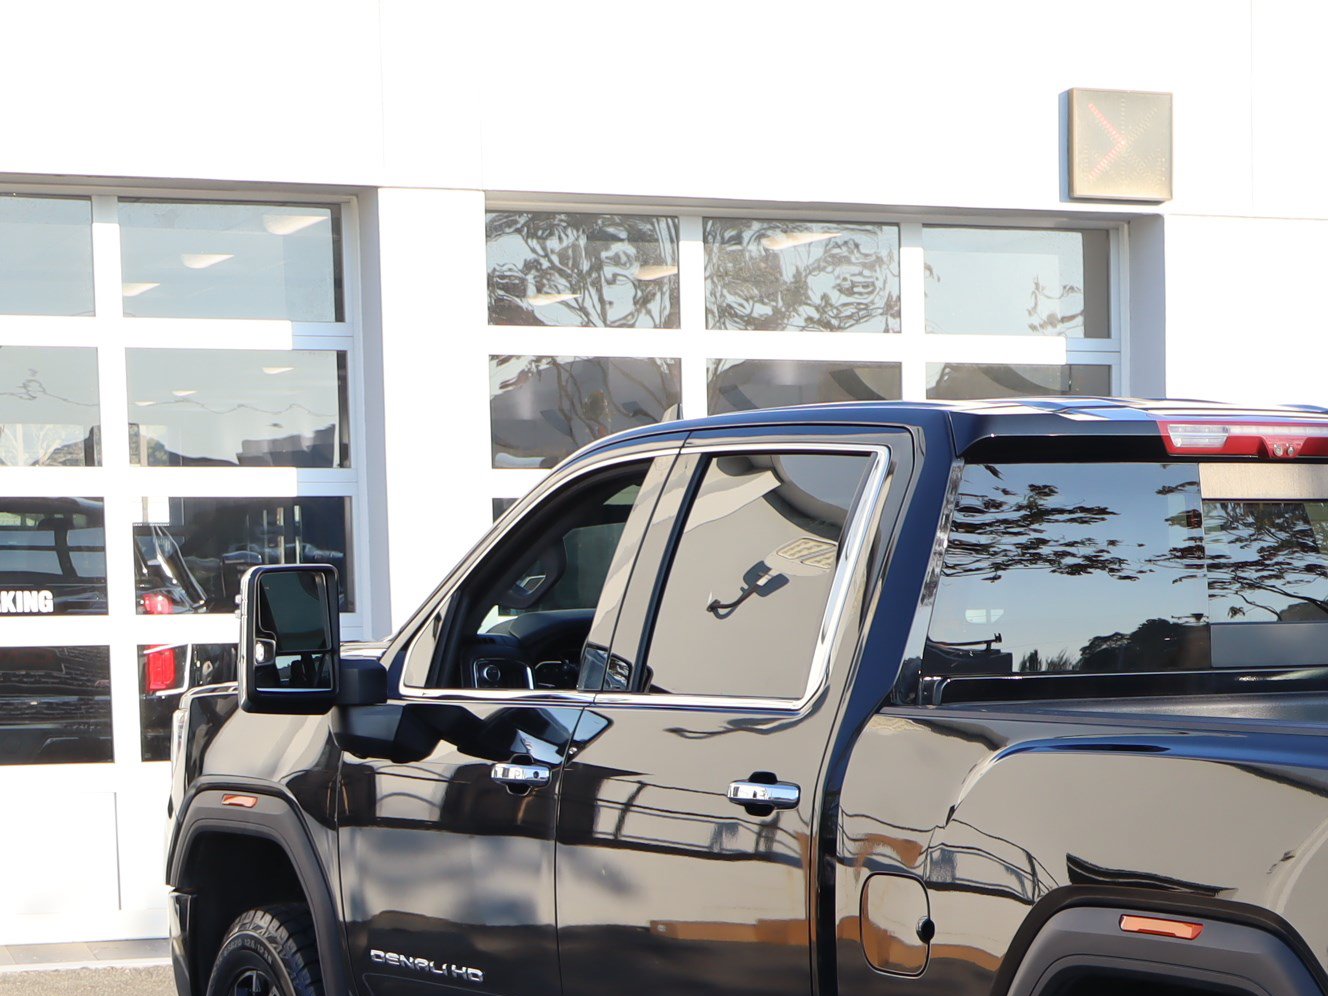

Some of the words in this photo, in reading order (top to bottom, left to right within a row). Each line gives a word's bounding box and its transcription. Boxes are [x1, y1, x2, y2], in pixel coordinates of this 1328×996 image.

[0, 590, 54, 613] KING
[370, 949, 448, 976] DENALI
[451, 964, 484, 982] HD
